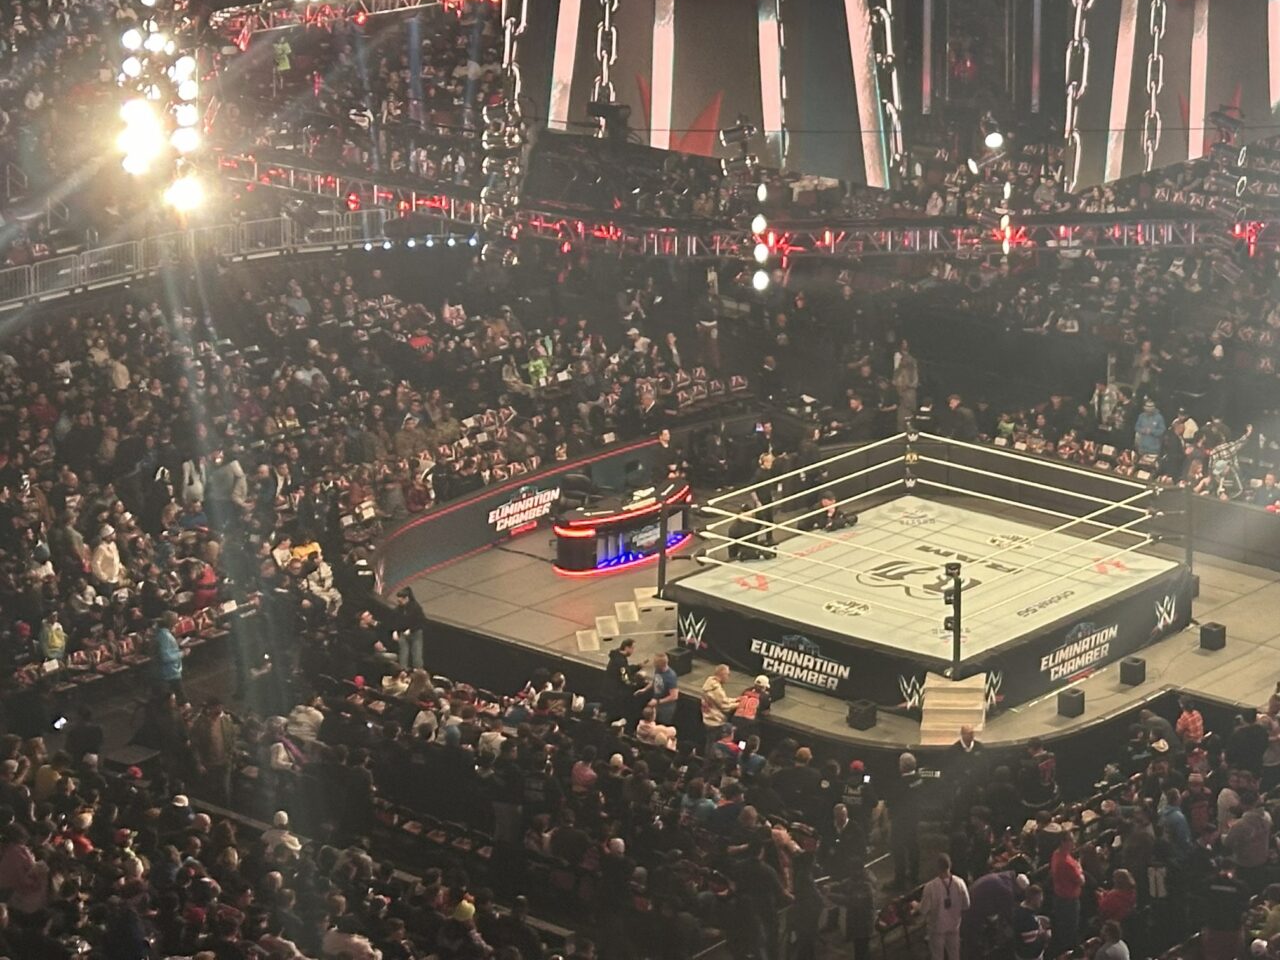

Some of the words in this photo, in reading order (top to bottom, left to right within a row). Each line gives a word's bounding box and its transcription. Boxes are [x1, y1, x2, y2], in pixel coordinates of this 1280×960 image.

[487, 487, 561, 525] ELIMINATION
[495, 502, 552, 532] CHAMBER
[750, 638, 851, 680] ELIMINATION
[1039, 624, 1119, 673] ELIMINATION
[1050, 642, 1110, 682] CHAMBER
[762, 657, 839, 690] CHAMBER
